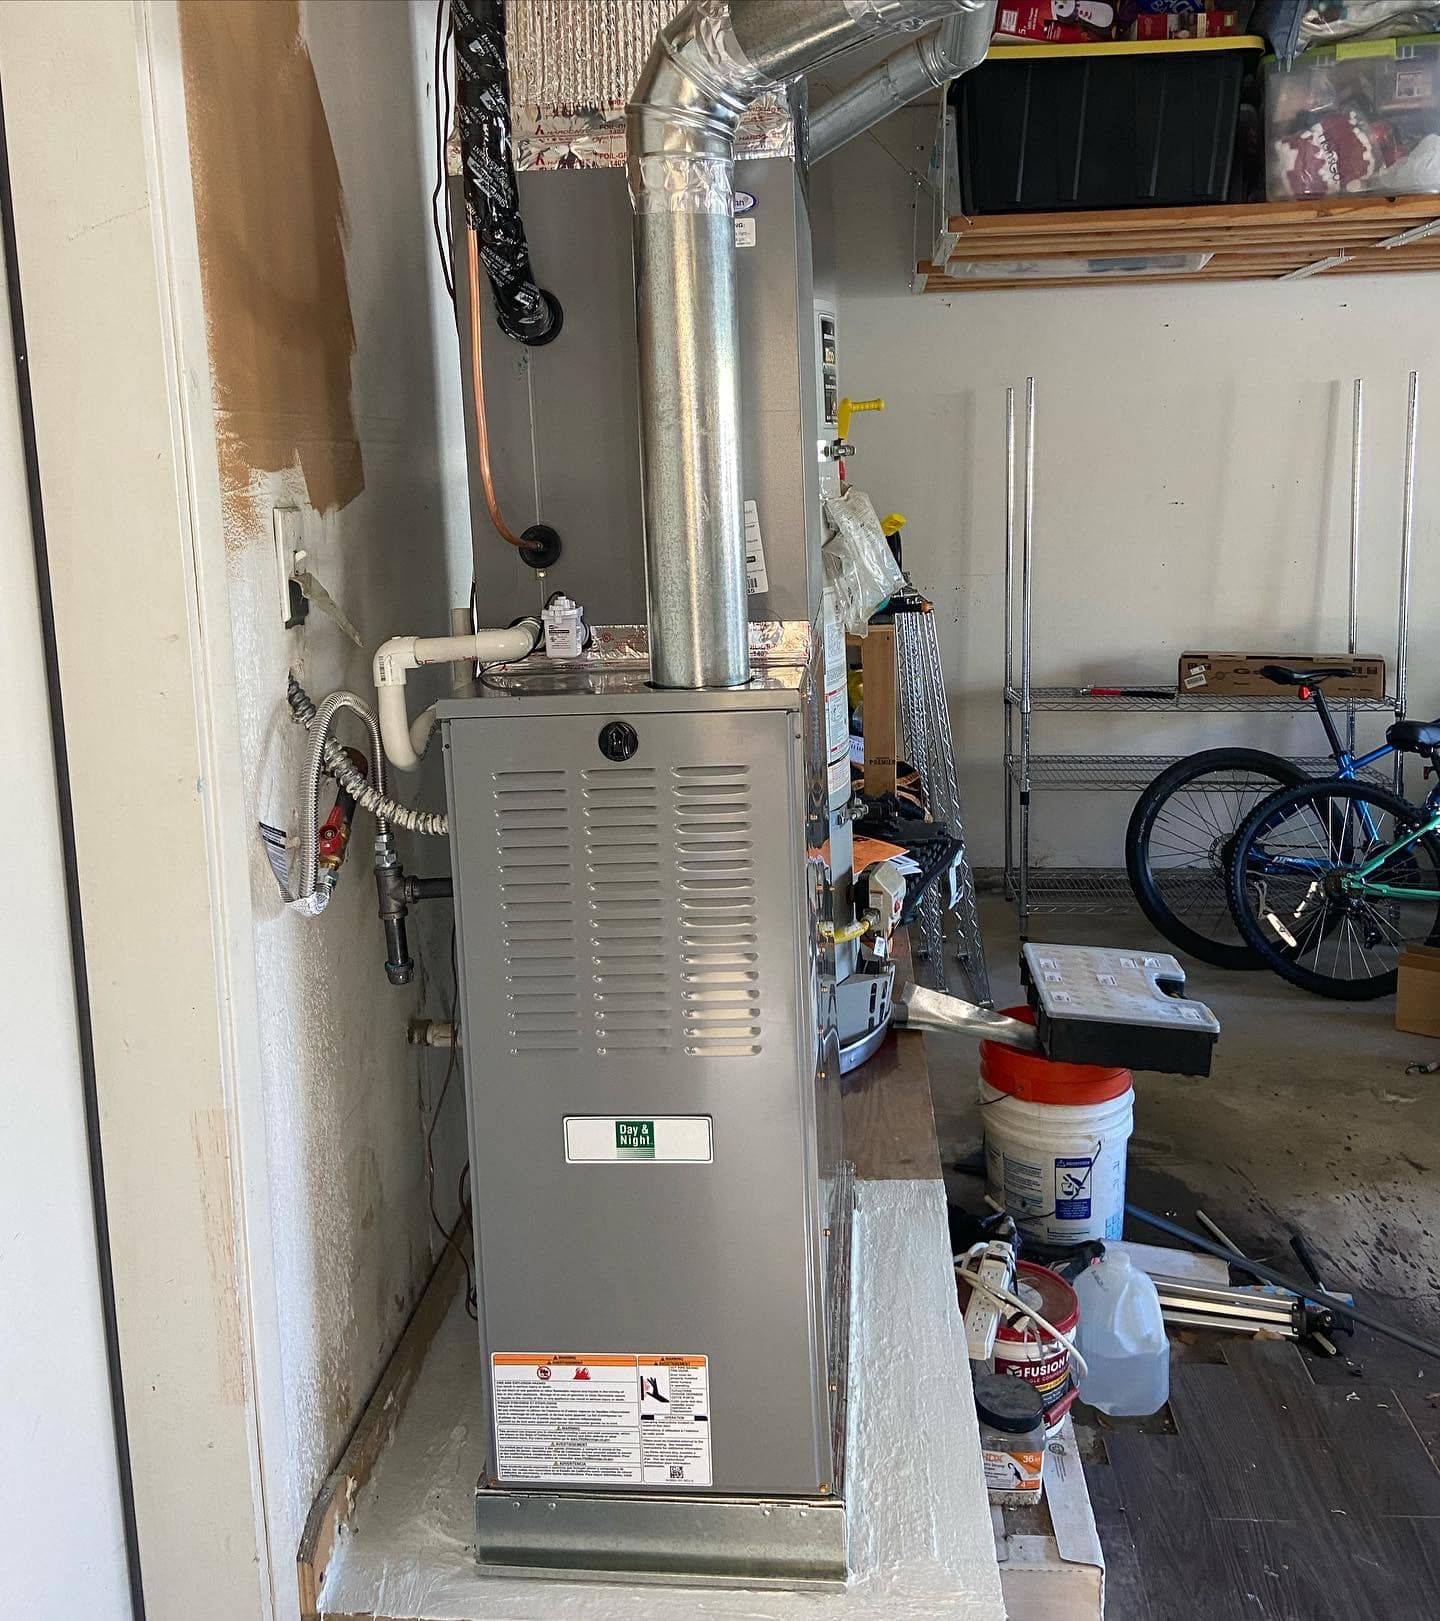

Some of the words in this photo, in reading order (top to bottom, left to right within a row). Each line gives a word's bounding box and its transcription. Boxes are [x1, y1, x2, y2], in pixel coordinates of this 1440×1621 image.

[619, 1124, 638, 1137] Day
[641, 1124, 649, 1135] &
[620, 1135, 650, 1147] Night
[1024, 1356, 1065, 1378] FUSION
[1022, 1455, 1034, 1463] 36
